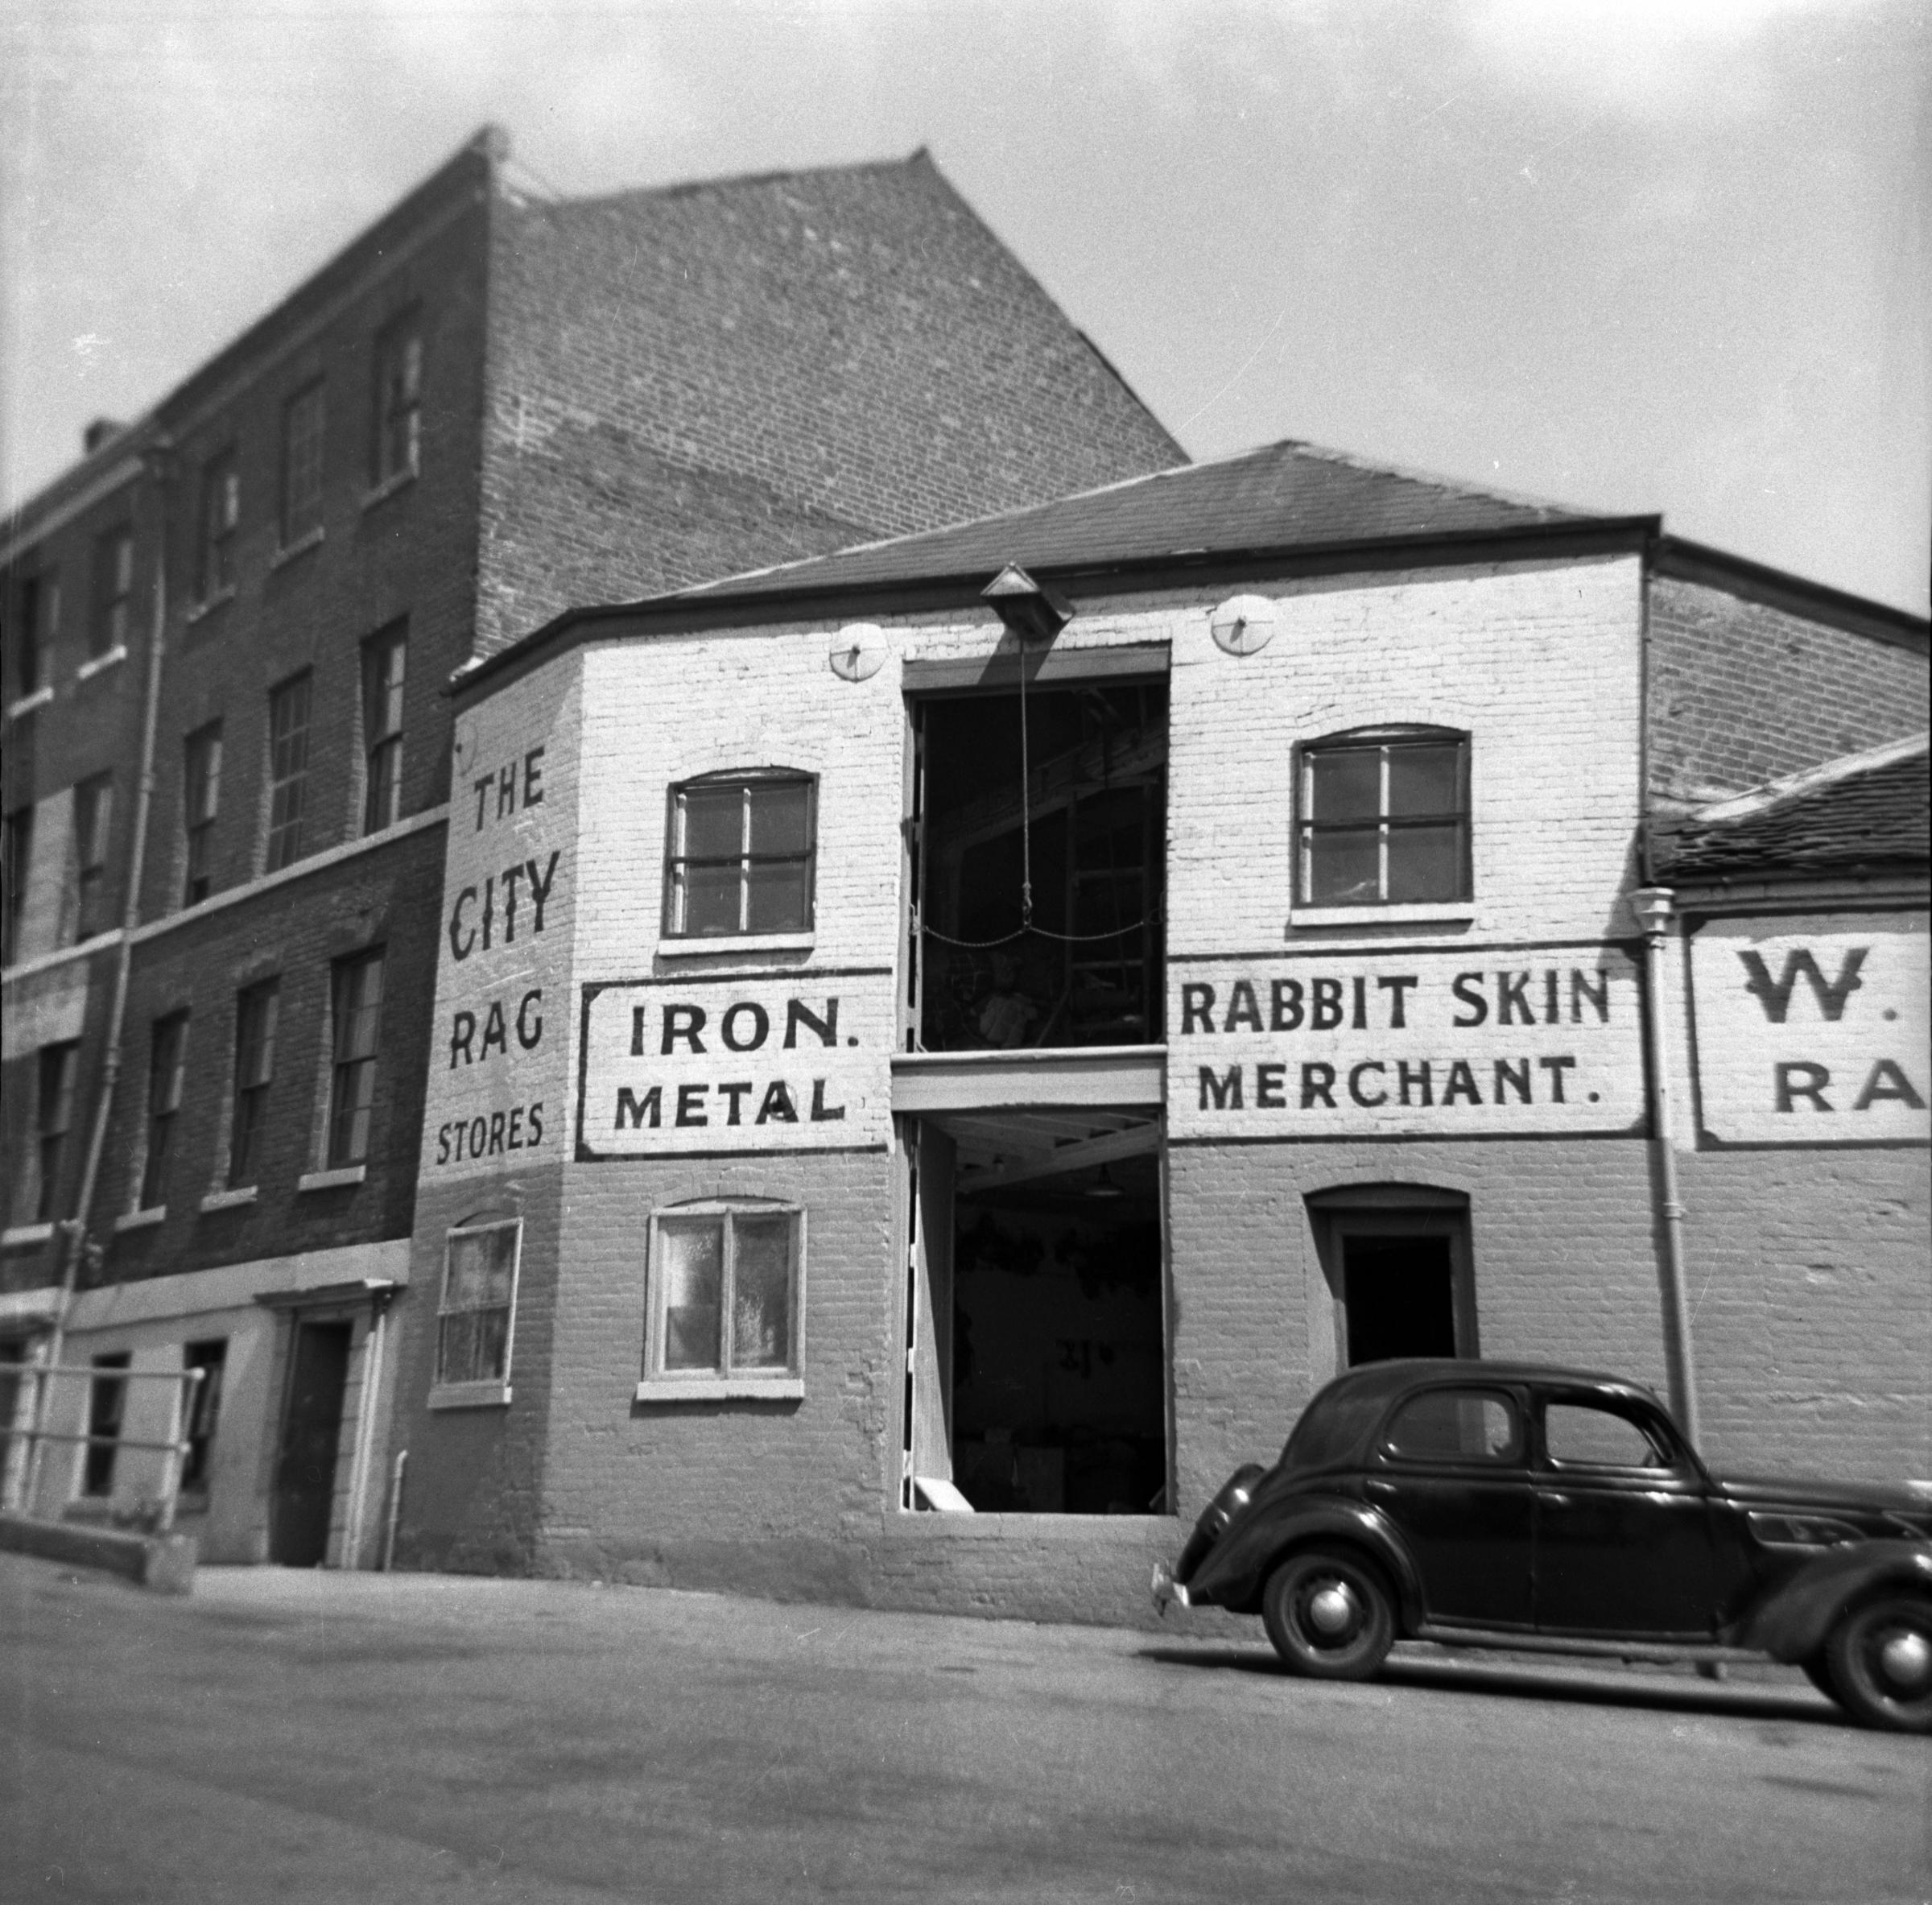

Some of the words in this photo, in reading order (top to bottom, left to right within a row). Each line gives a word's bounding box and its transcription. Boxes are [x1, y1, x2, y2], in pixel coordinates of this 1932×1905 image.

[474, 746, 545, 832] THE
[449, 850, 561, 962] CITY
[1181, 975, 1418, 1035] RABBIT
[1451, 969, 1609, 1028] SKIN
[1735, 946, 1898, 1023] W.
[450, 989, 543, 1069] RAG
[630, 998, 859, 1056] IRON.
[614, 1078, 845, 1130] METAL
[1198, 1056, 1600, 1110] MERCHANT.
[436, 1101, 543, 1165] STORES
